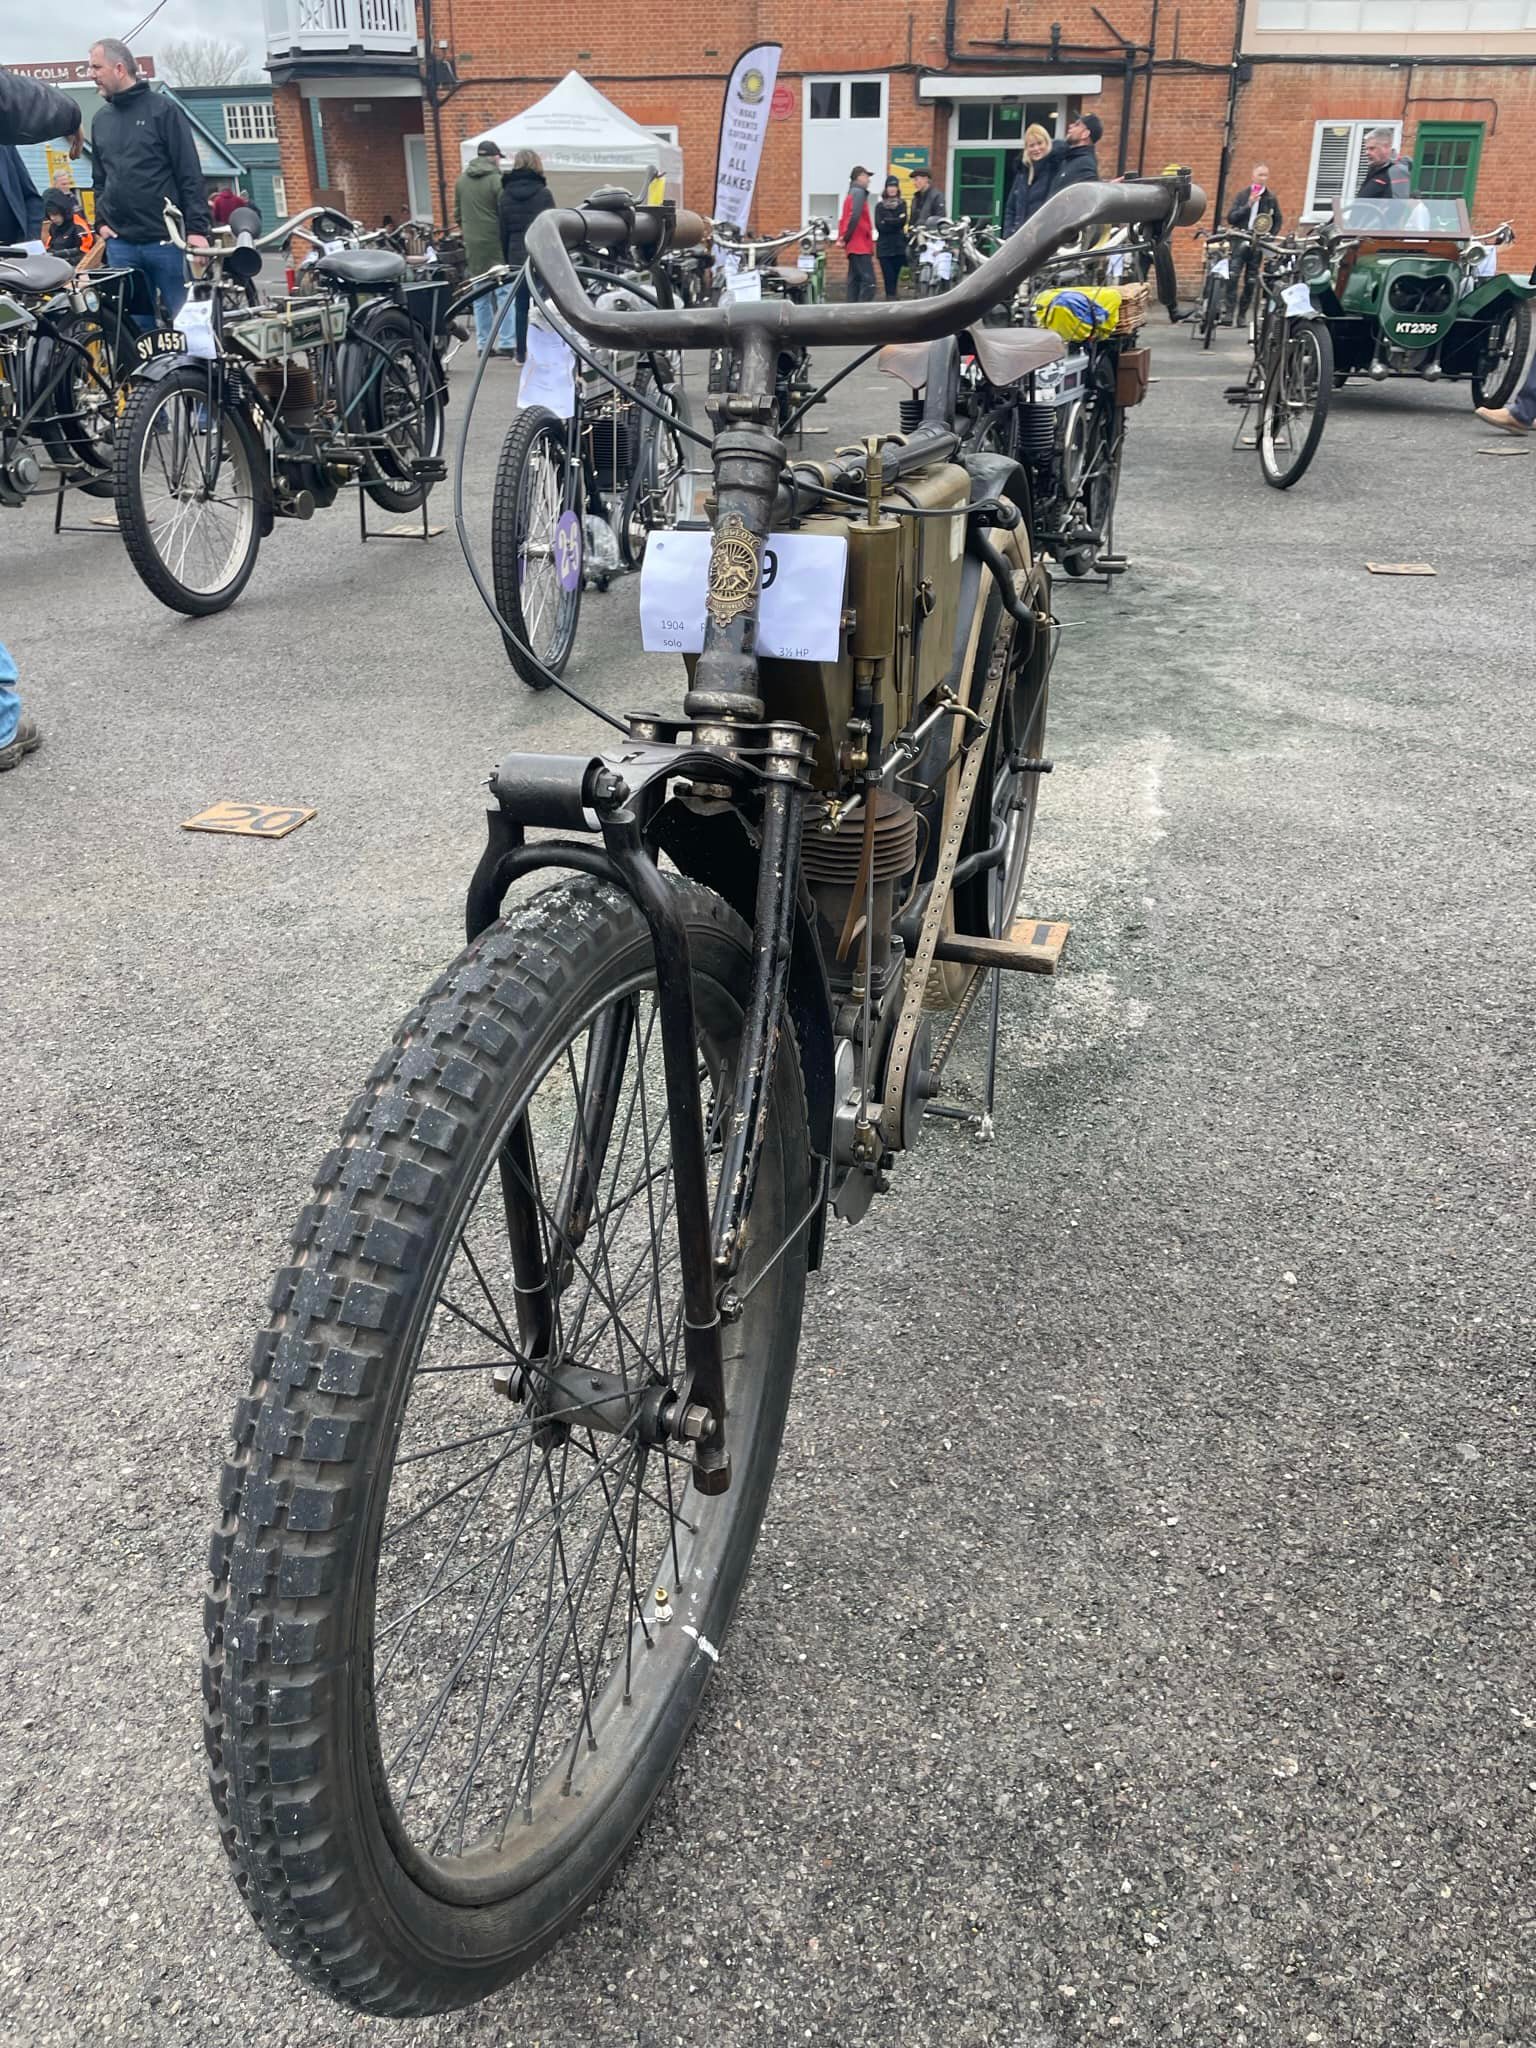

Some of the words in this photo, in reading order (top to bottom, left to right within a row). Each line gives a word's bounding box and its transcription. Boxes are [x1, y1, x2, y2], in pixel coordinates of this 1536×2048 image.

[728, 157, 747, 172] ALL
[719, 173, 753, 192] MAKES
[1395, 322, 1438, 334] KT2395
[137, 336, 153, 360] SV
[158, 332, 186, 351] 4551
[661, 619, 684, 631] 1904
[663, 638, 682, 648] solo
[795, 648, 809, 657] HP
[193, 806, 304, 832] 20
